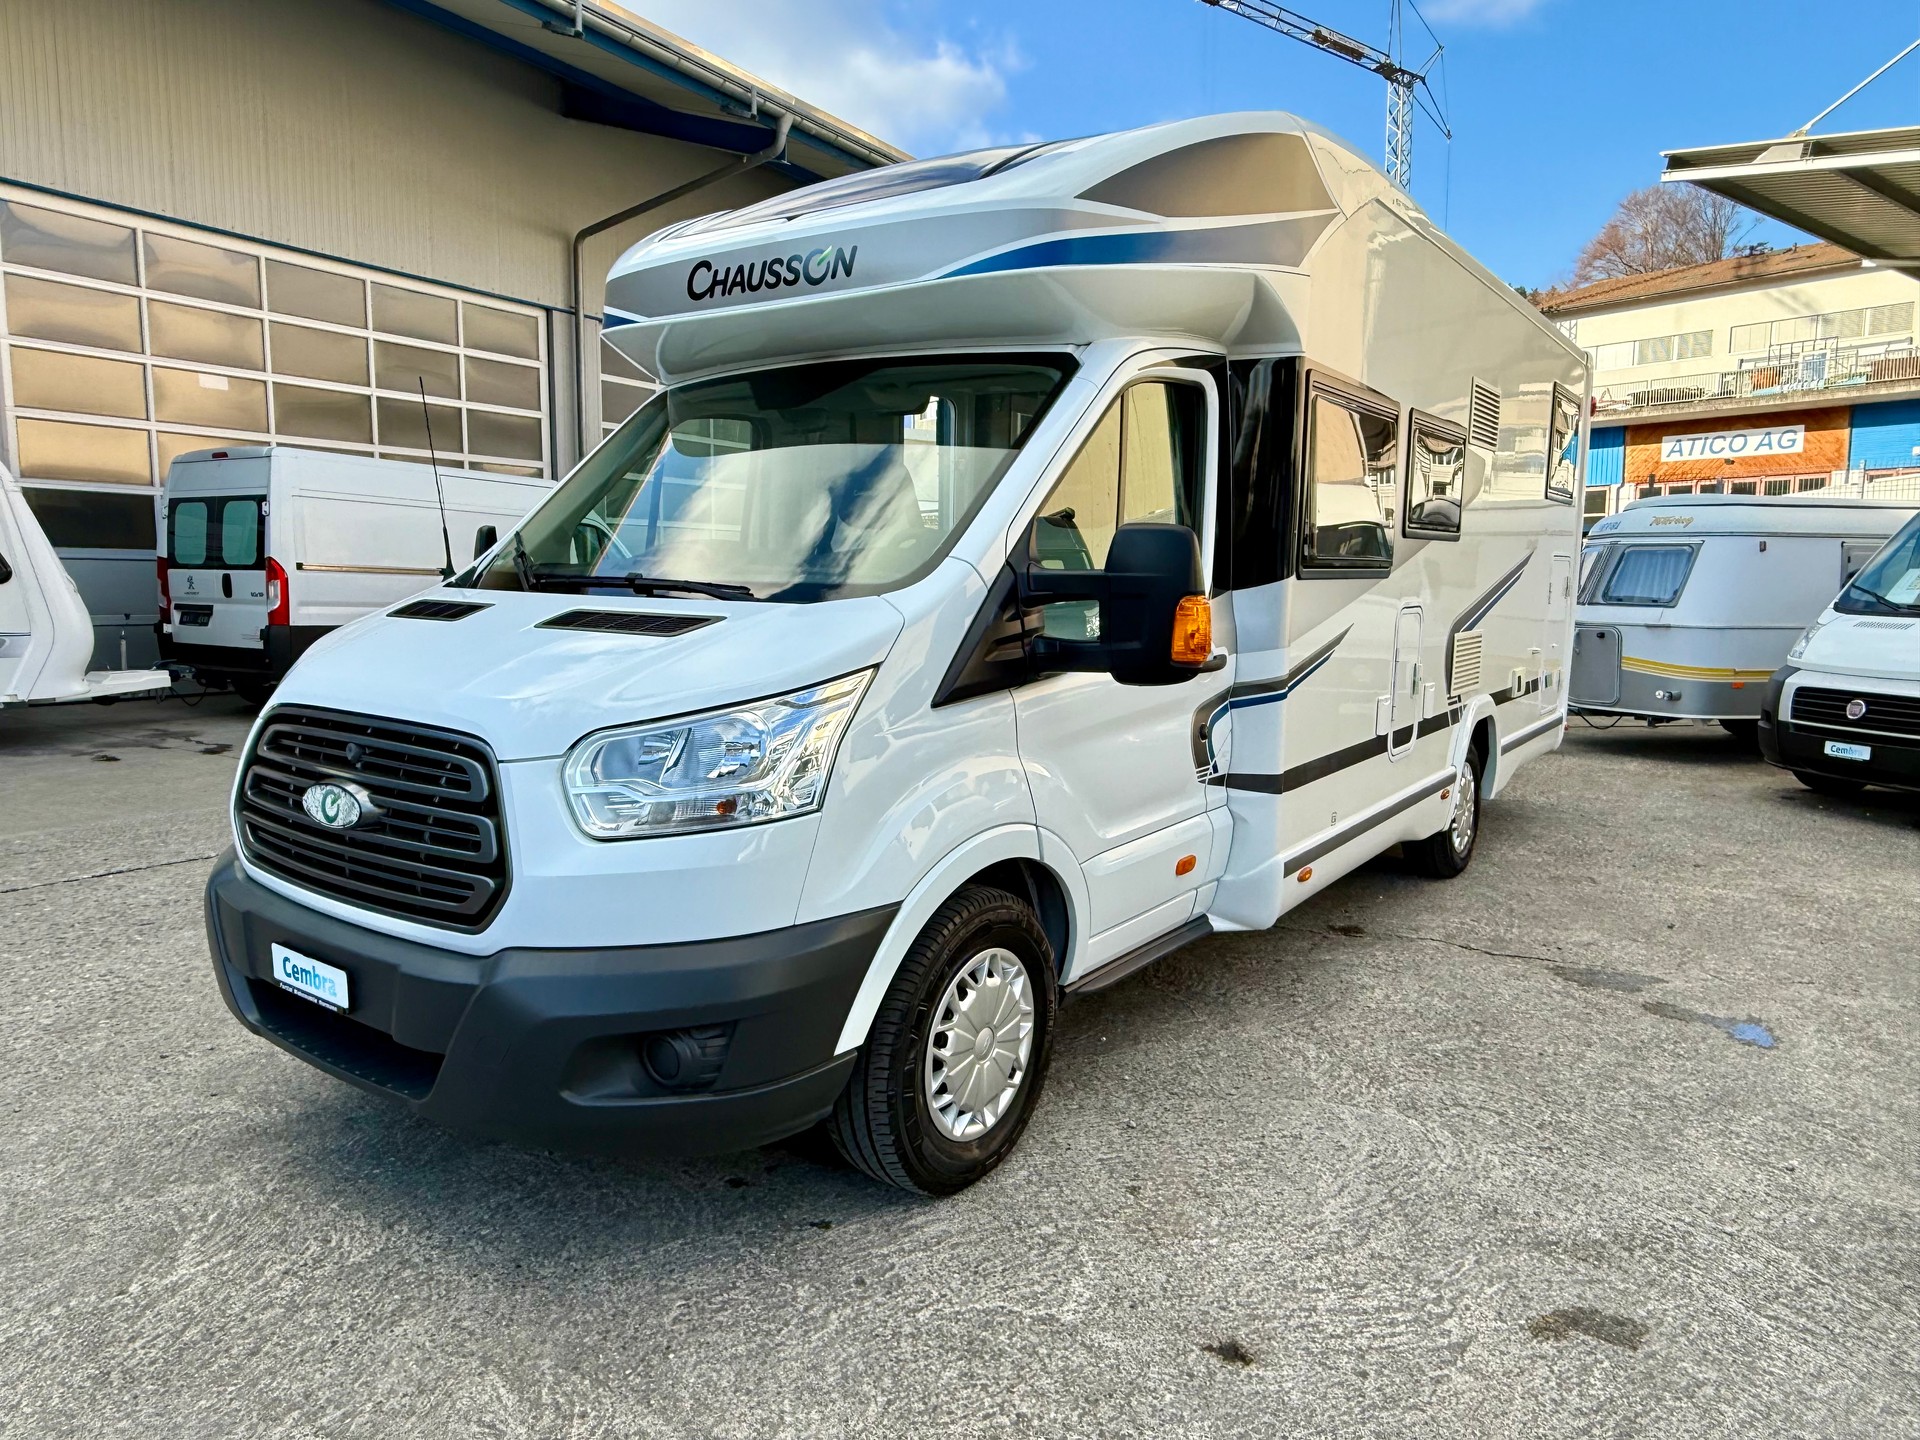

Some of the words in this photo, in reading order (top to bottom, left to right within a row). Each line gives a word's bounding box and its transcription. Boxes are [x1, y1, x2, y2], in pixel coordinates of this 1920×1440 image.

[686, 245, 858, 301] CHAUSSON
[1666, 433, 1748, 458] ATICO
[1754, 429, 1798, 452] AG
[282, 956, 338, 998] Cembra
